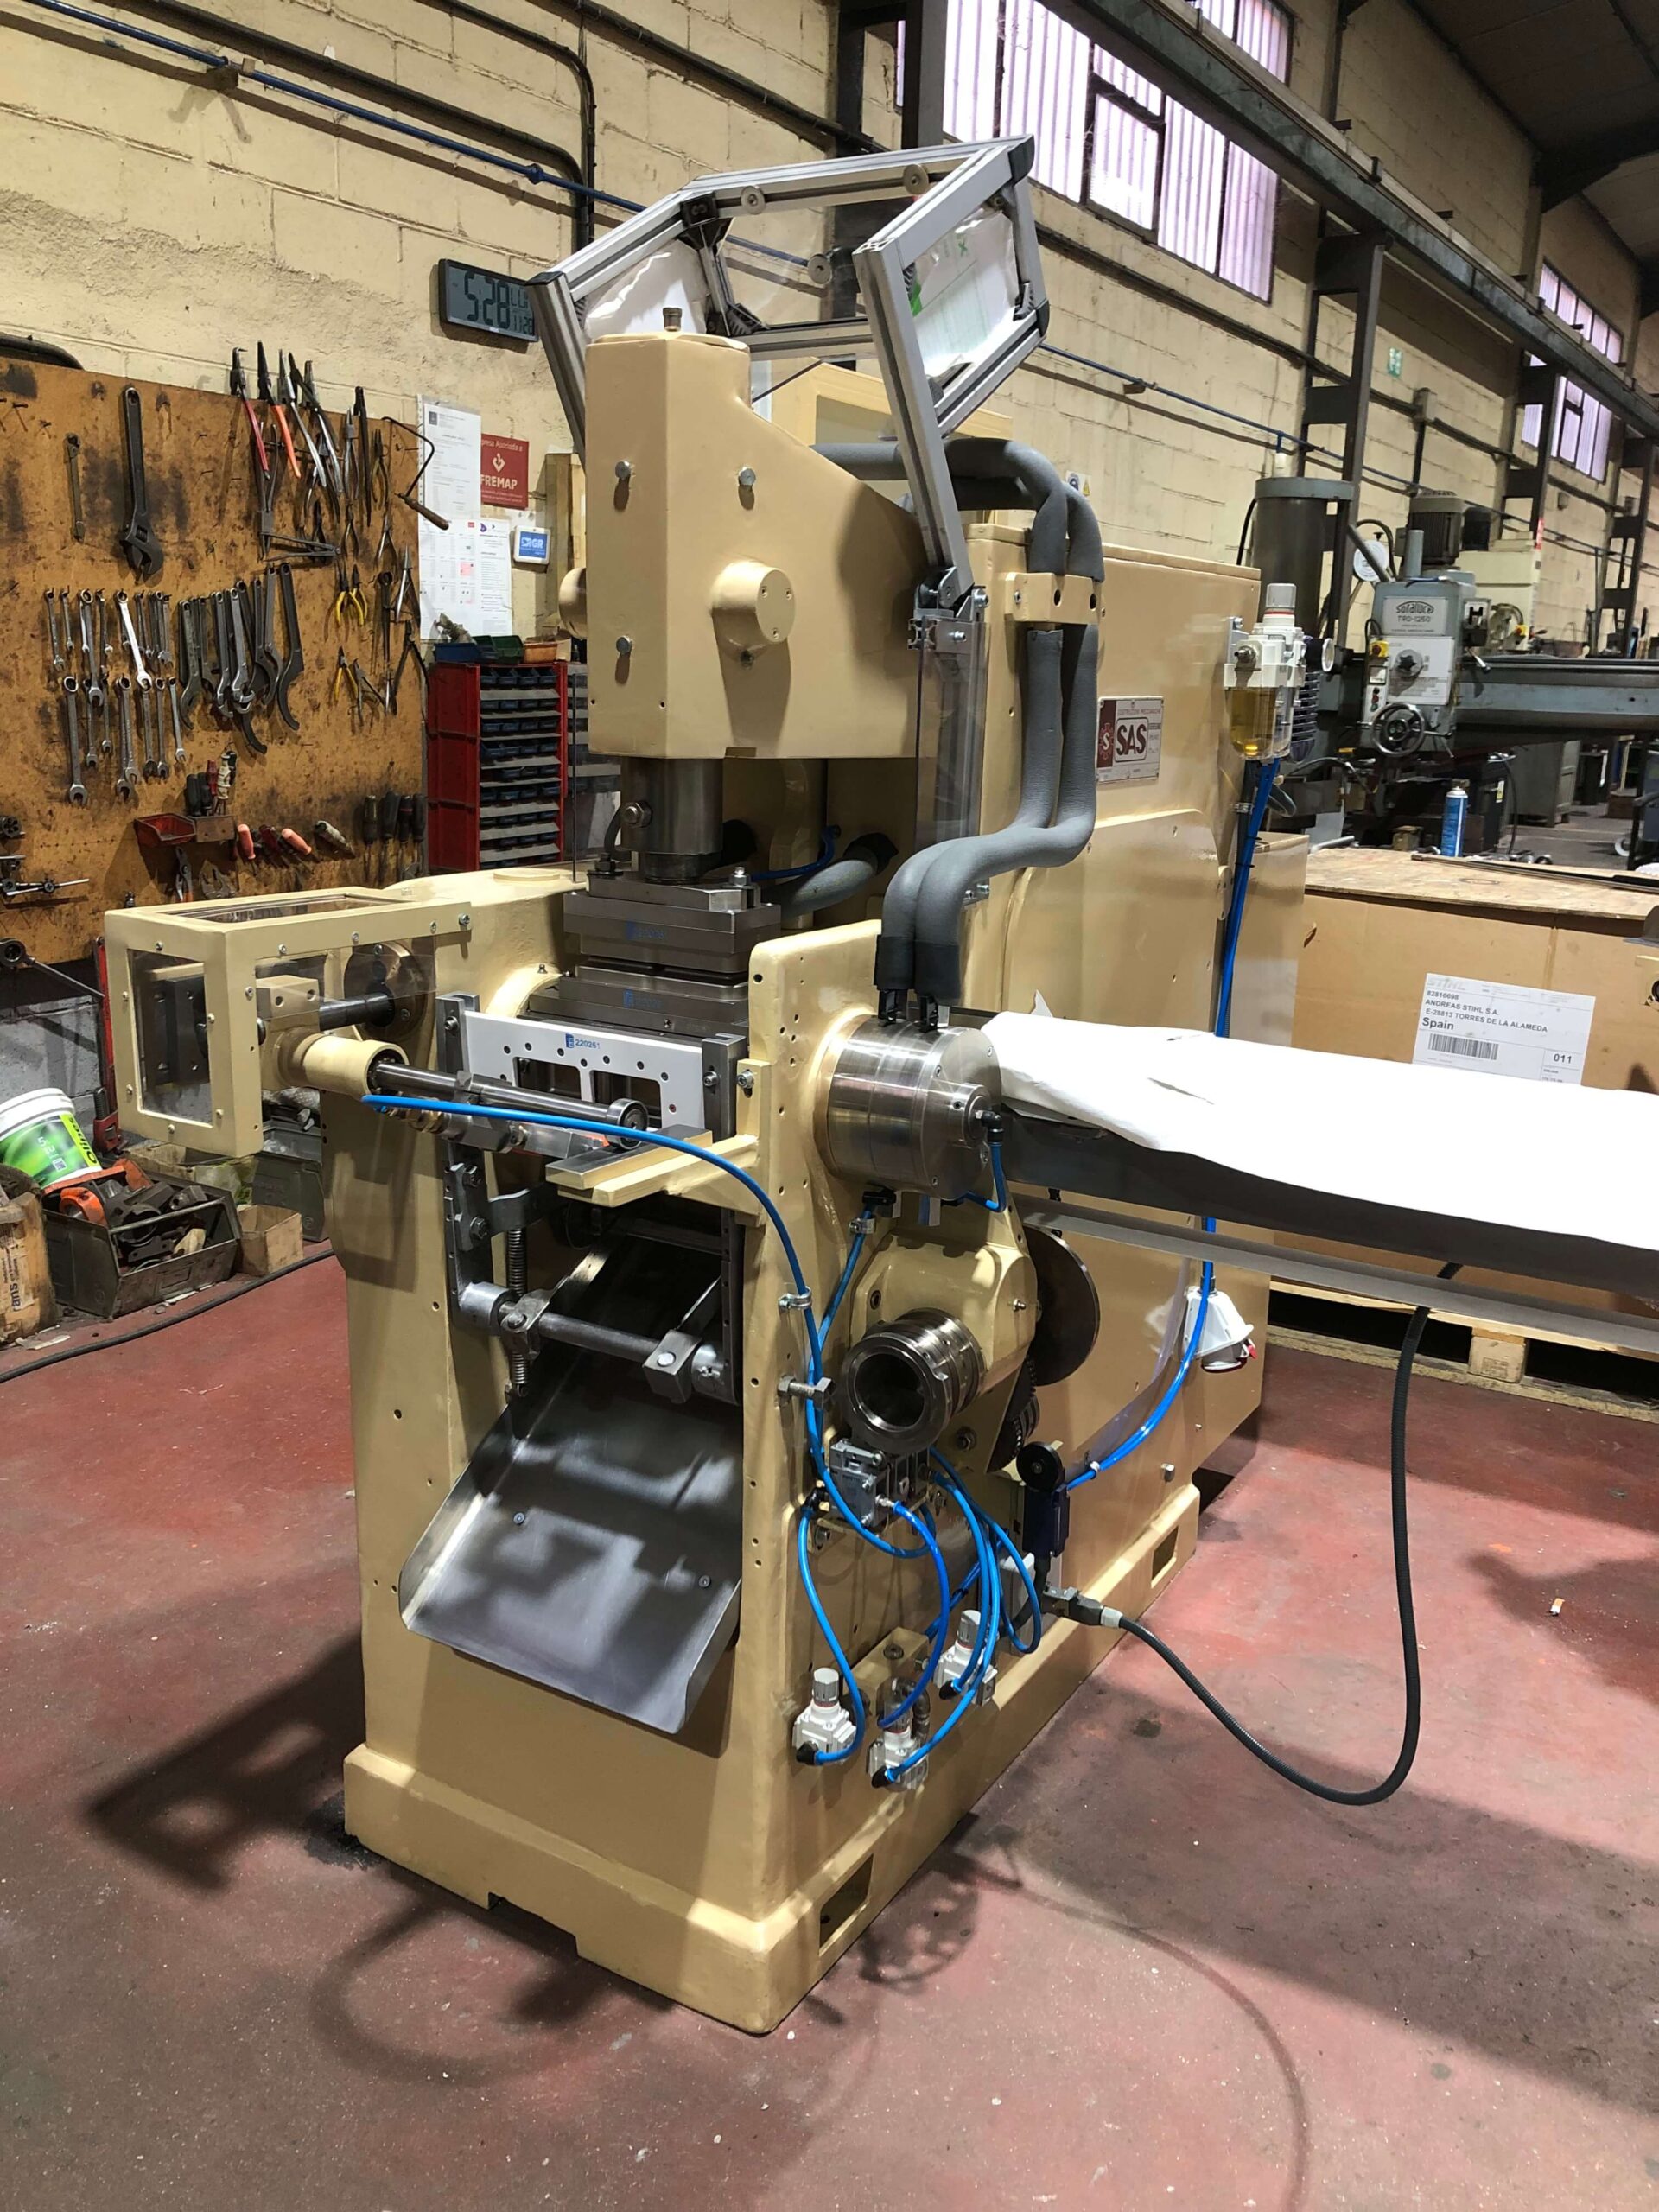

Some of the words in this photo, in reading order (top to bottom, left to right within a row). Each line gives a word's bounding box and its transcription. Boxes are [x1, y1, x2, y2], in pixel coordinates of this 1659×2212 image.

[480, 474, 518, 490] FREMAP
[1116, 724, 1147, 755] SAS
[1425, 999, 1461, 1010] ANDREAS
[1462, 1004, 1484, 1014] STIHL
[1485, 1007, 1499, 1016] S.A.
[1422, 1017, 1454, 1031] Spain
[1426, 1007, 1454, 1019] E-28813
[1455, 1012, 1485, 1023] TORRES
[1486, 1016, 1497, 1026] DE
[1498, 1019, 1509, 1027] LA
[1510, 1020, 1548, 1033] ALAMEDA
[575, 1039, 601, 1050] 220251
[1553, 1052, 1573, 1065] 011
